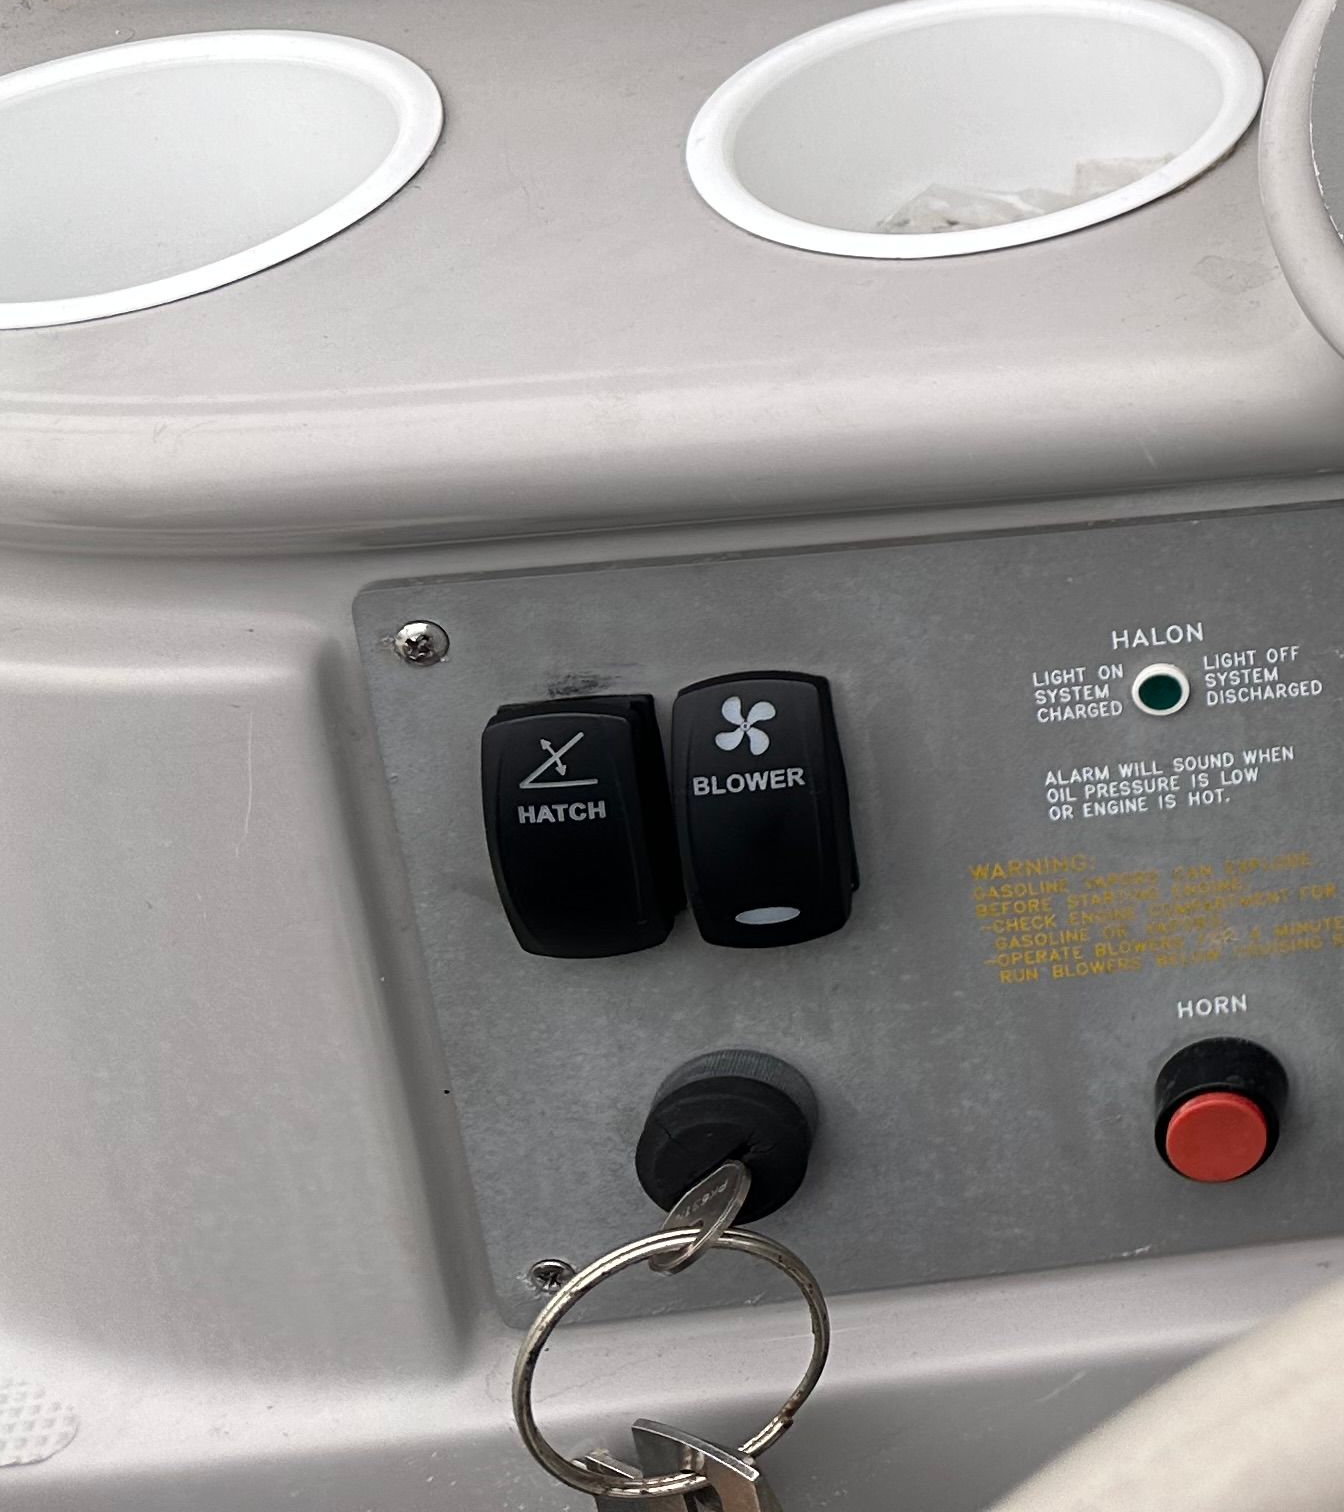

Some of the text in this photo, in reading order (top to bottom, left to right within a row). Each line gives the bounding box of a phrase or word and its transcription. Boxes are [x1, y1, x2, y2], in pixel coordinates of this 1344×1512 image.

[1111, 622, 1205, 650] HALON
[1203, 645, 1300, 670] LIGHT OFF
[1032, 663, 1124, 687] LIGHT ON
[1204, 666, 1279, 687] SYSTEM
[1035, 684, 1110, 705] SYSTEM
[1206, 679, 1323, 706] DISCHARGED
[1036, 701, 1123, 723] CHARGED
[1045, 745, 1295, 787] ALARM WILL SOUND WHEN
[692, 767, 805, 796] BLOWER
[1046, 767, 1260, 803] OIL PRESSURE IS LOW
[517, 800, 606, 824] HATCH
[1048, 788, 1231, 821] OR ENGINE IS HOT.
[976, 898, 1051, 919] BEFORE
[995, 928, 1089, 951] GASOLINE
[999, 968, 1038, 984] RUN
[1053, 956, 1142, 979] BLOWERS
[1177, 993, 1248, 1018] HORN
